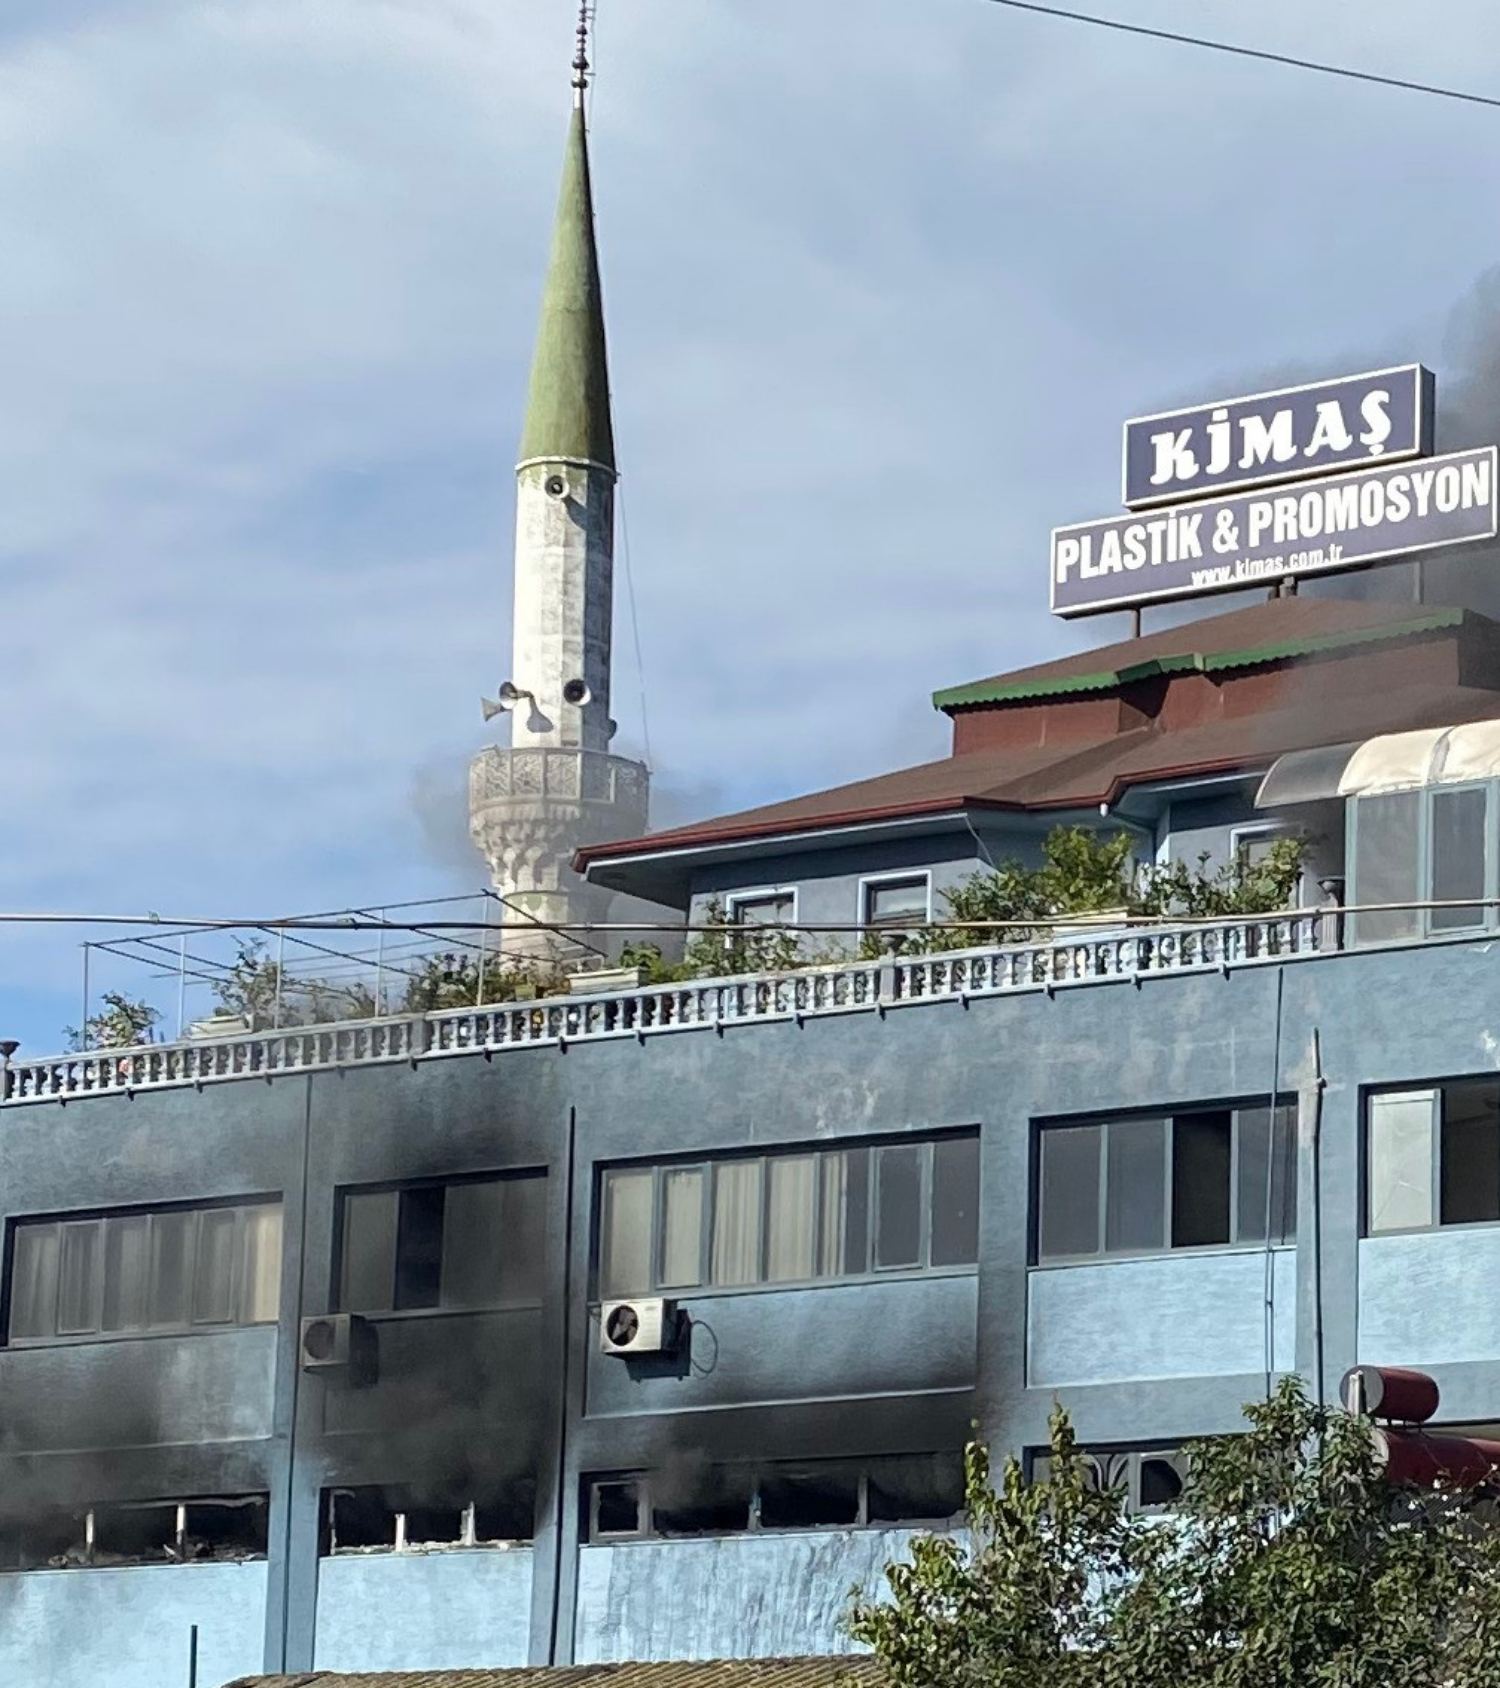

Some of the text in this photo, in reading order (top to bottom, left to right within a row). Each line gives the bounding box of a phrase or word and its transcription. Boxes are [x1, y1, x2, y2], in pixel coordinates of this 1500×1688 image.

[1150, 390, 1392, 485] KİMAŞ
[1056, 460, 1490, 584] PLASTİK & PROMOSYON
